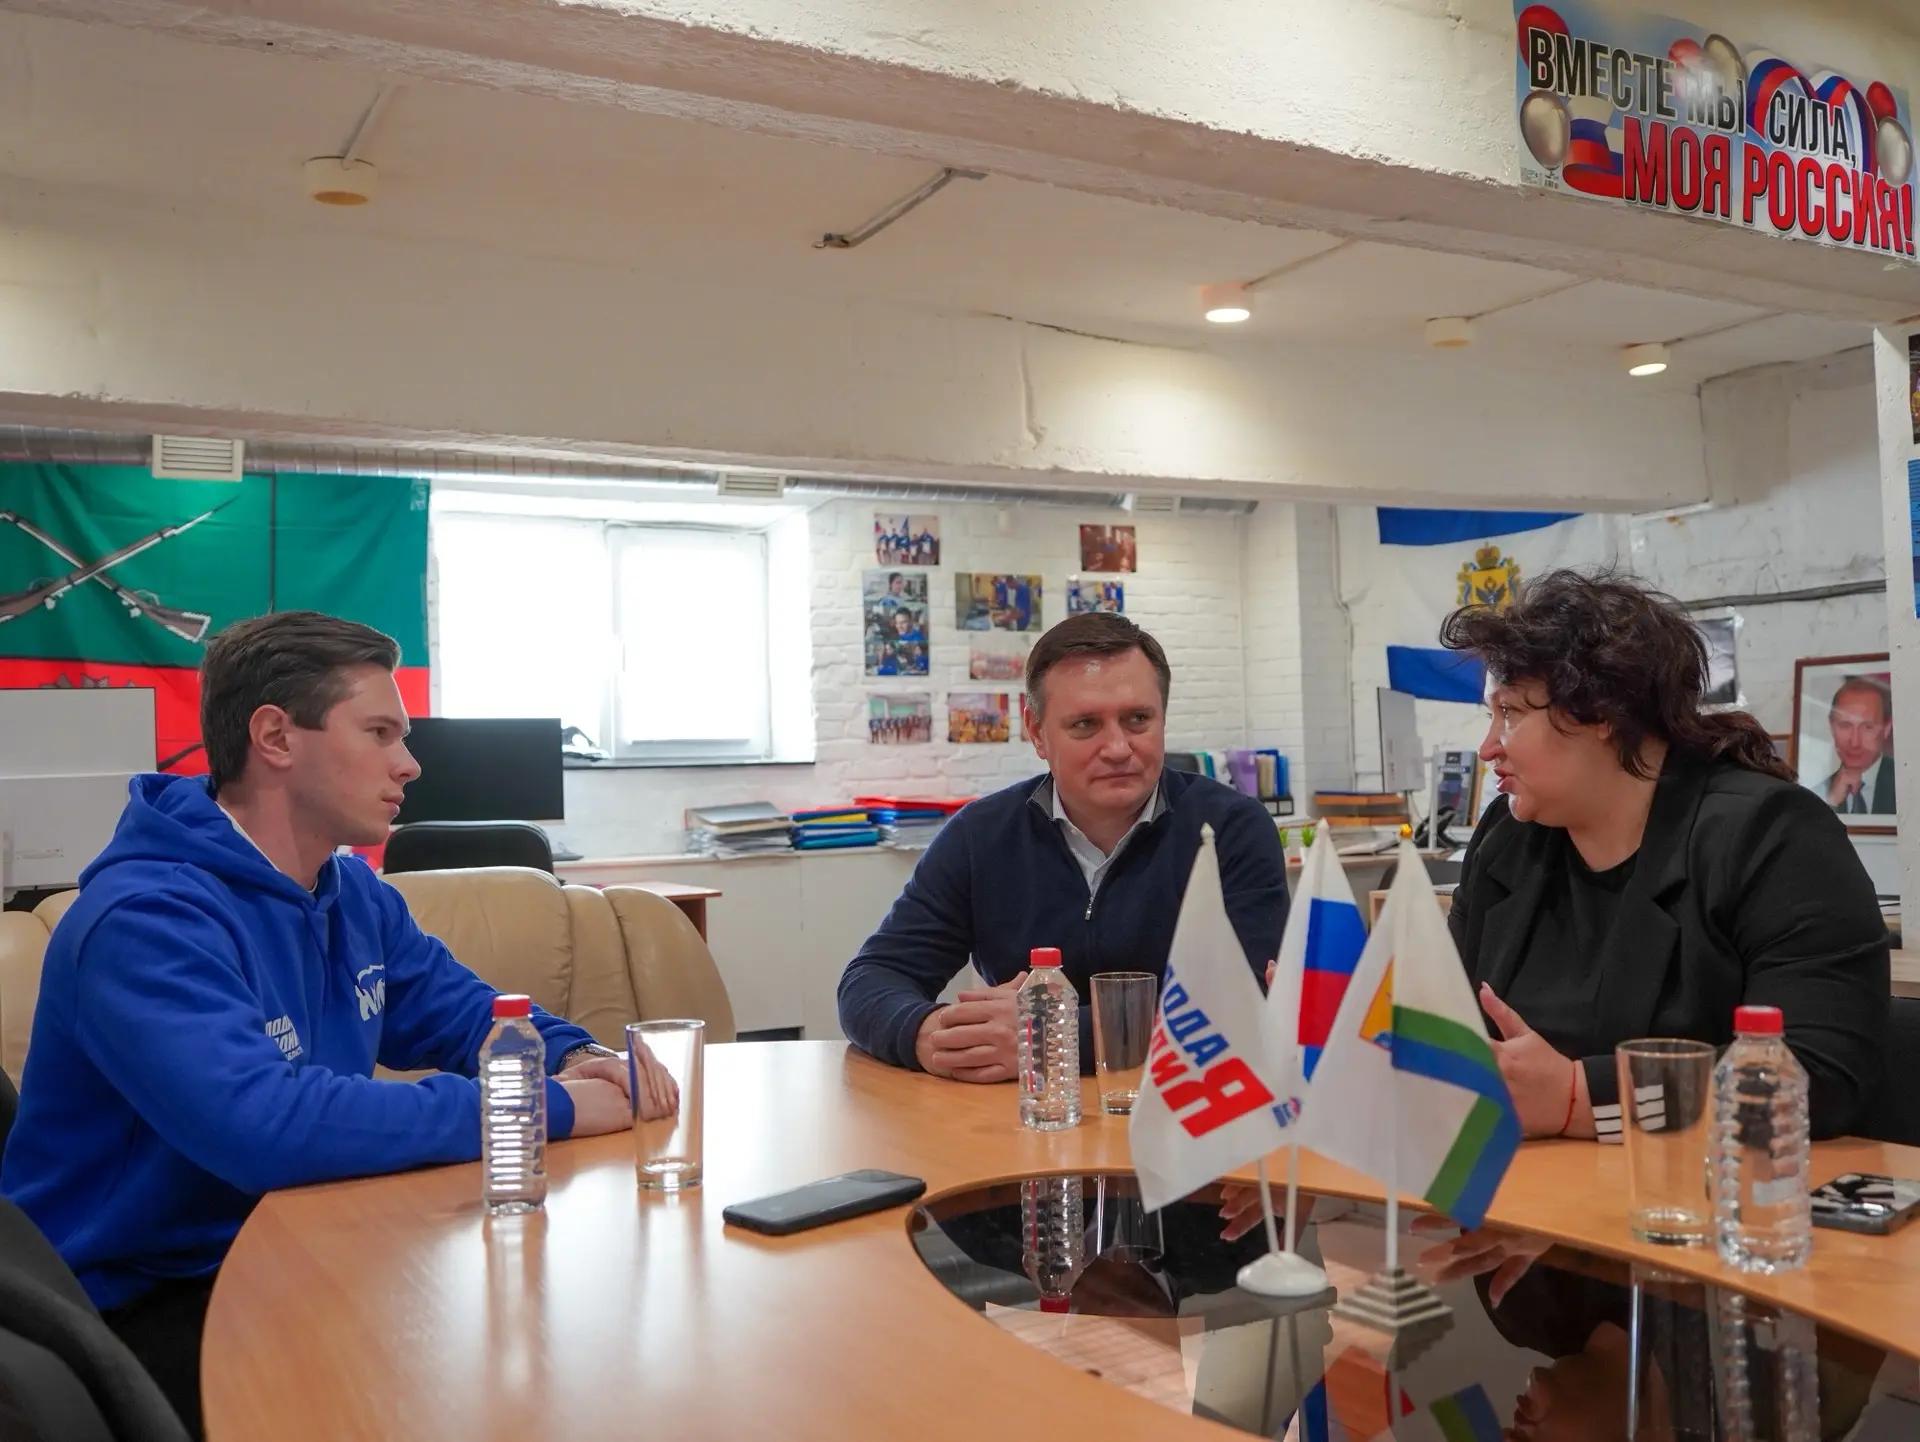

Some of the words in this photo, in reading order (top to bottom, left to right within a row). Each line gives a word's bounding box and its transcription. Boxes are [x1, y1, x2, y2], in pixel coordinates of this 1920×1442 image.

[1528, 28, 1678, 119] ВМЕСТЕ
[1768, 88, 1858, 169] СИЛА,
[1623, 116, 1732, 219] МОЯ
[1743, 141, 1916, 256] РОССИЯ!
